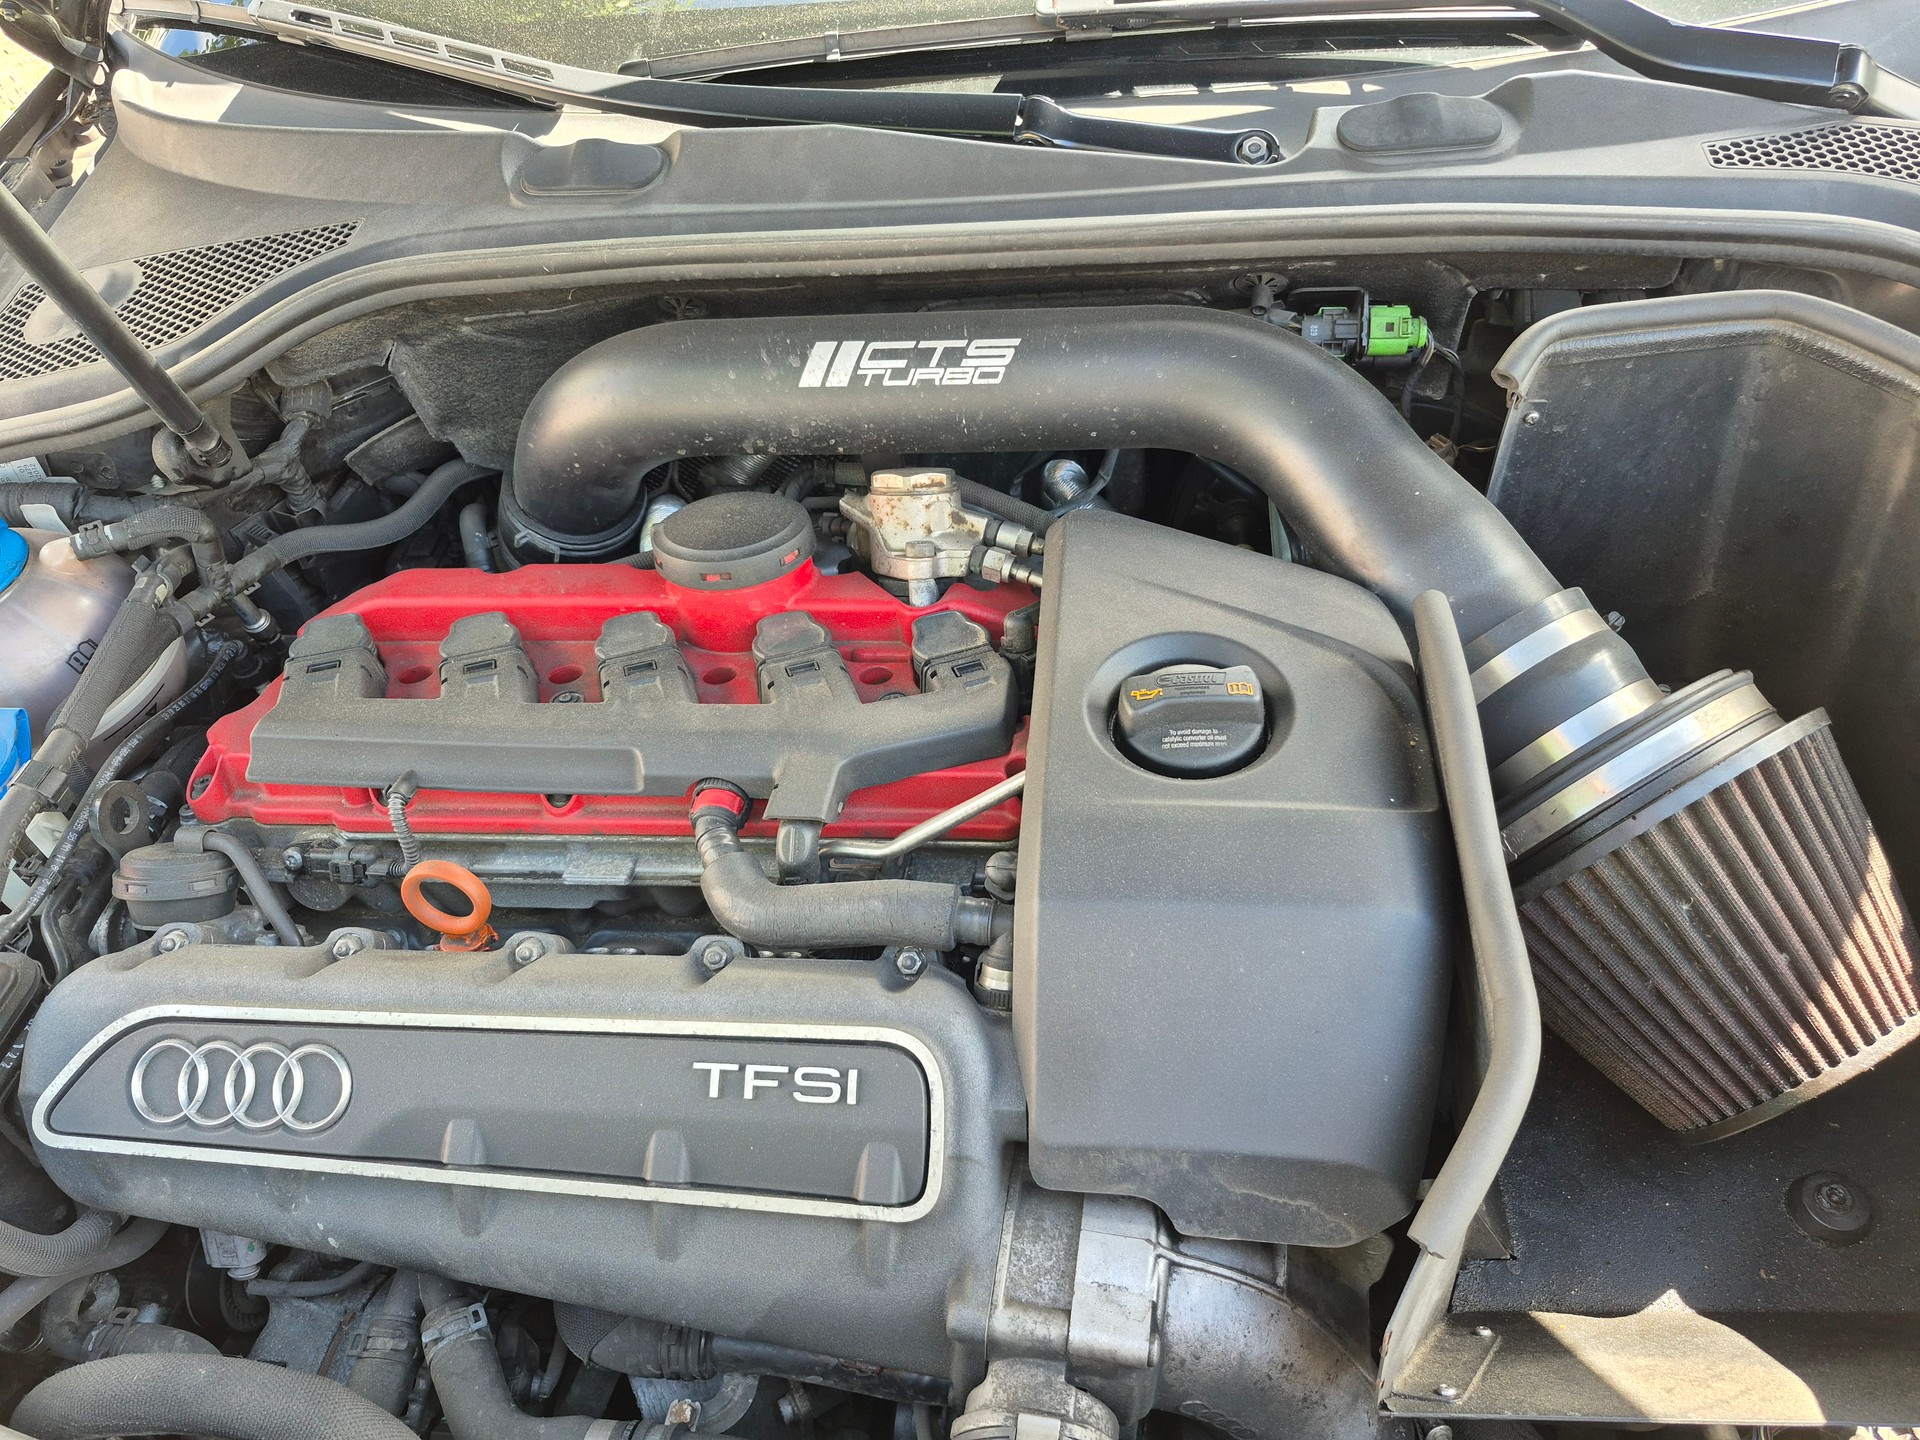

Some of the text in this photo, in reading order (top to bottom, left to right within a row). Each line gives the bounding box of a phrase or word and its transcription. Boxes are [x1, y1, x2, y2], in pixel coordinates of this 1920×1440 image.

[859, 337, 1022, 368] CTS
[857, 367, 1006, 386] TURBO
[1172, 673, 1217, 685] Castrol
[692, 1061, 858, 1105] TFSI
